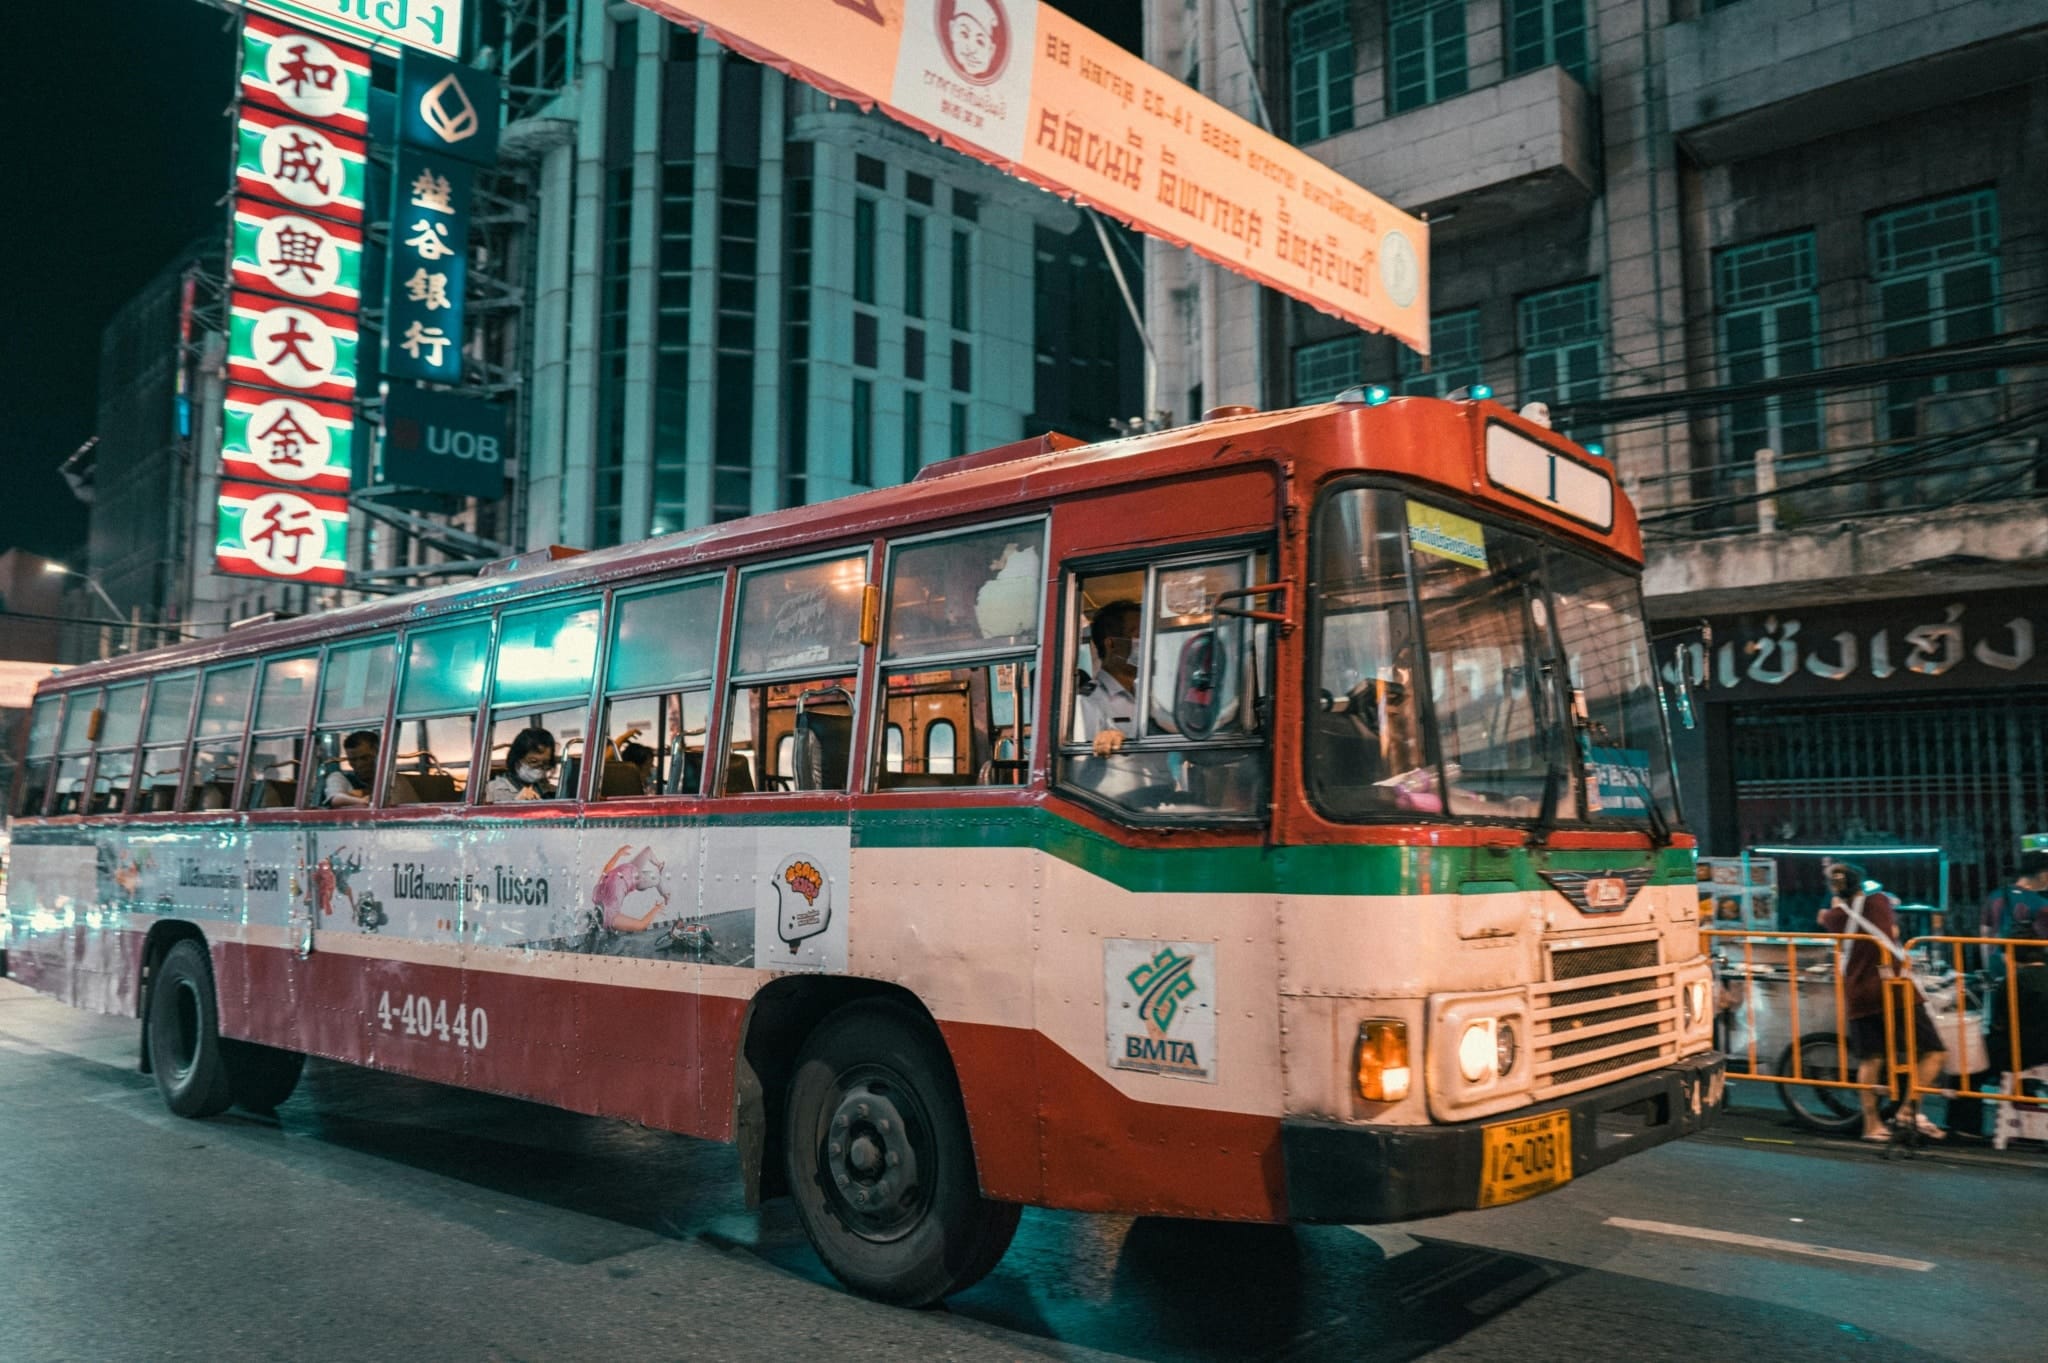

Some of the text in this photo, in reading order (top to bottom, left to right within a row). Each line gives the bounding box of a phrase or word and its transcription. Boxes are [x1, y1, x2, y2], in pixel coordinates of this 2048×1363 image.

[249, 44, 338, 566] 和成興大金行
[427, 426, 499, 463] UOB
[495, 865, 549, 906] ไม่รอด
[378, 990, 489, 1051] 4-40440
[1126, 1036, 1199, 1066] BMTA
